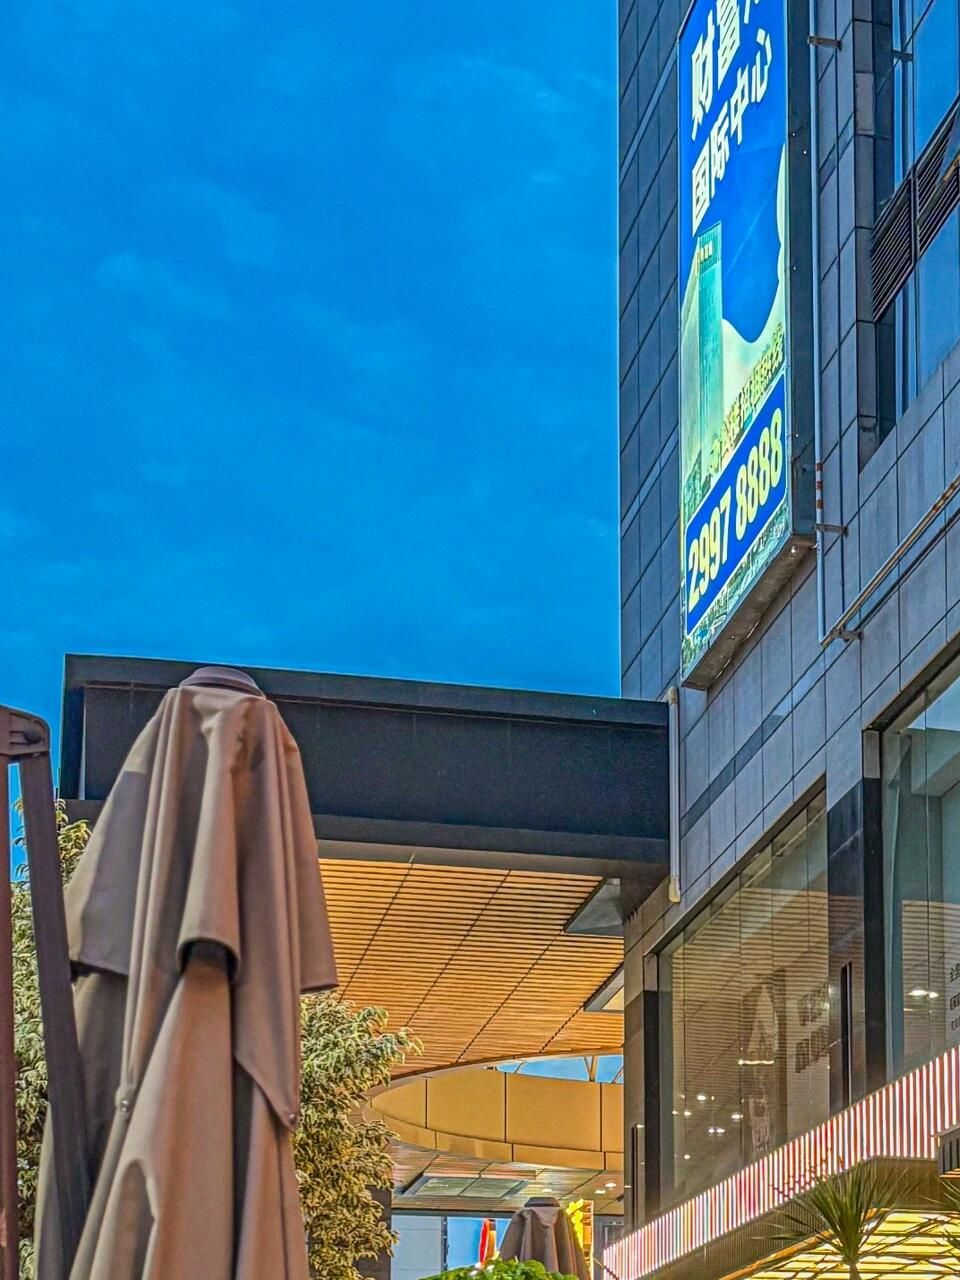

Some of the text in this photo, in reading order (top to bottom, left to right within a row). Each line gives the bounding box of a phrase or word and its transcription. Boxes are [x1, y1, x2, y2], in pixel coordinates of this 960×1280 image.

[692, 28, 773, 237] 国际中心
[687, 486, 732, 613] 2997
[735, 407, 782, 541] 8888
